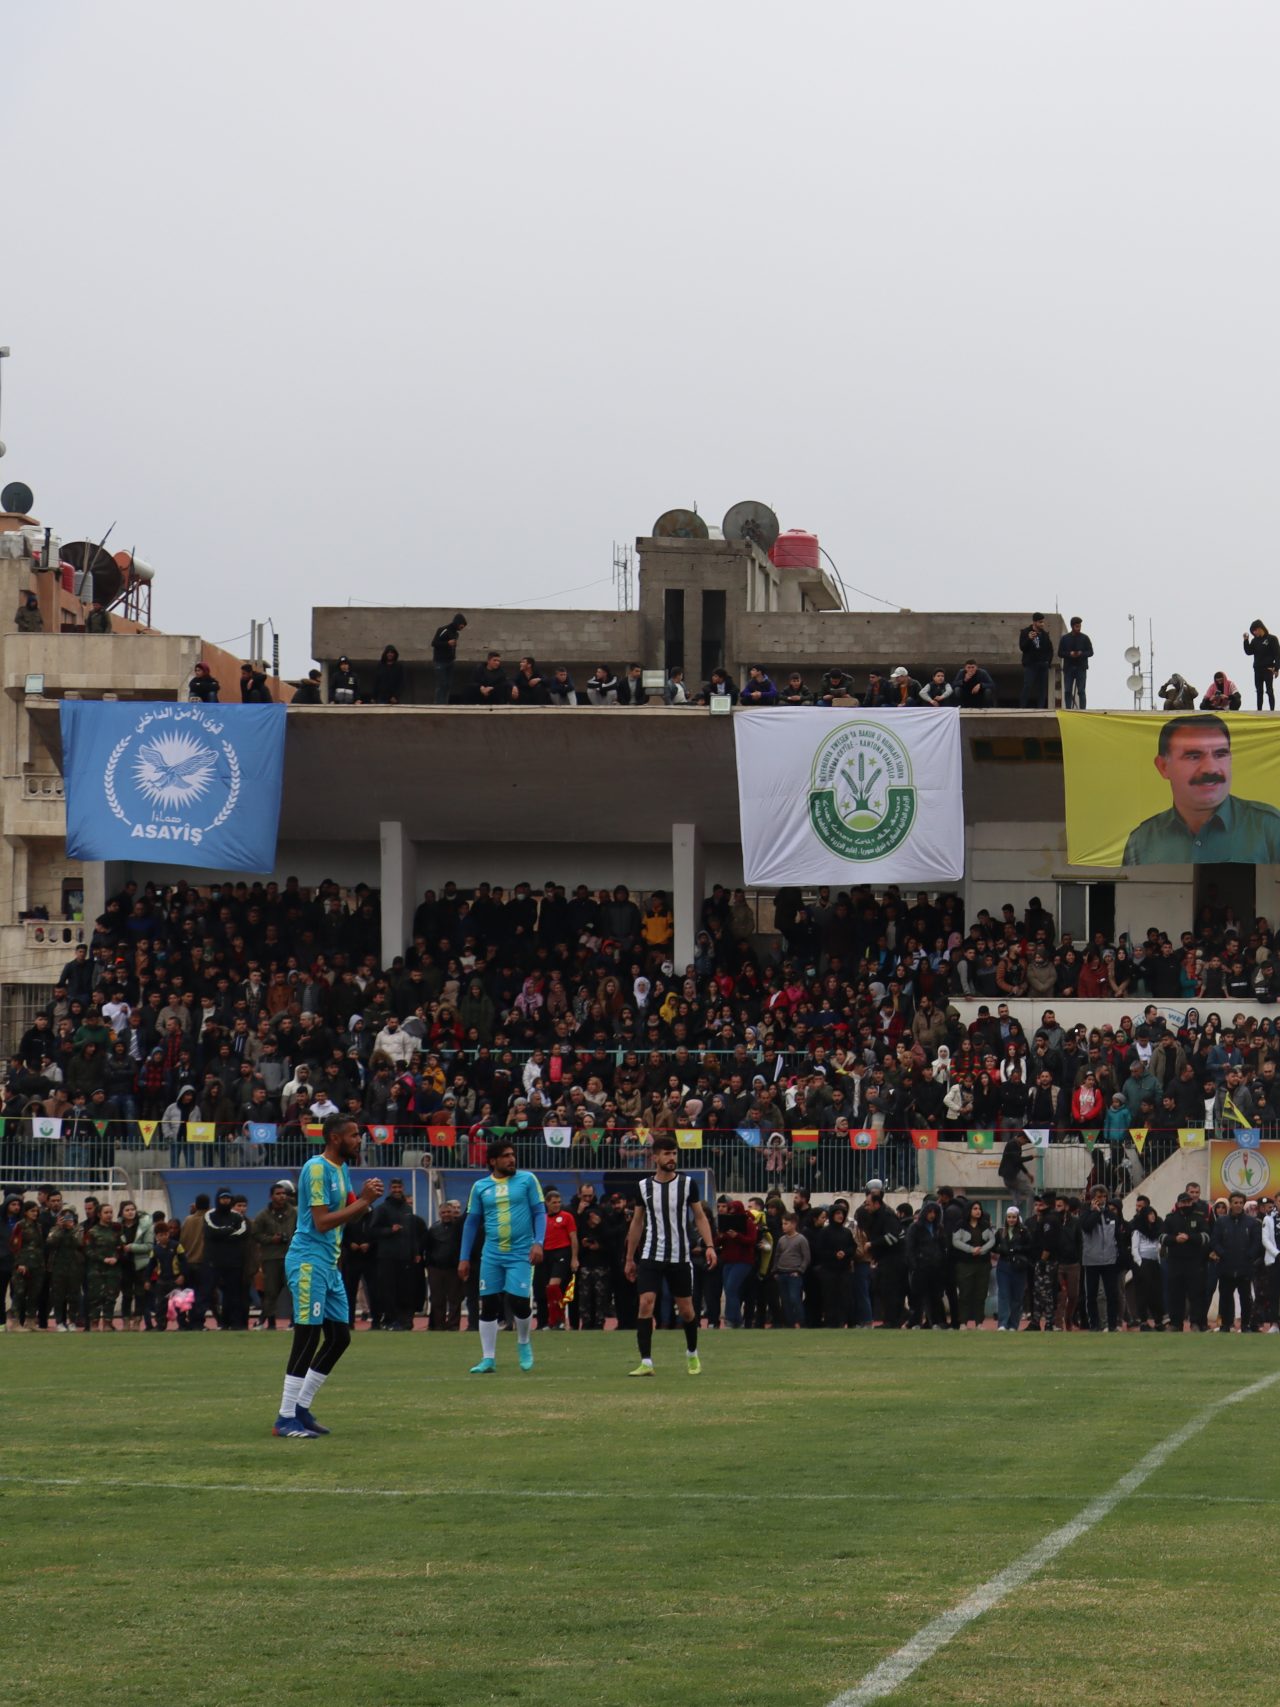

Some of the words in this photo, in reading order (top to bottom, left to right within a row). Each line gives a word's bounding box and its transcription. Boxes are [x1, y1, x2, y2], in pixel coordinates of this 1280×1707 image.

[135, 706, 173, 734] الداخلي
[202, 718, 225, 735] قوى
[130, 823, 203, 846] ASAYÎŞ
[312, 1301, 321, 1317] 8
